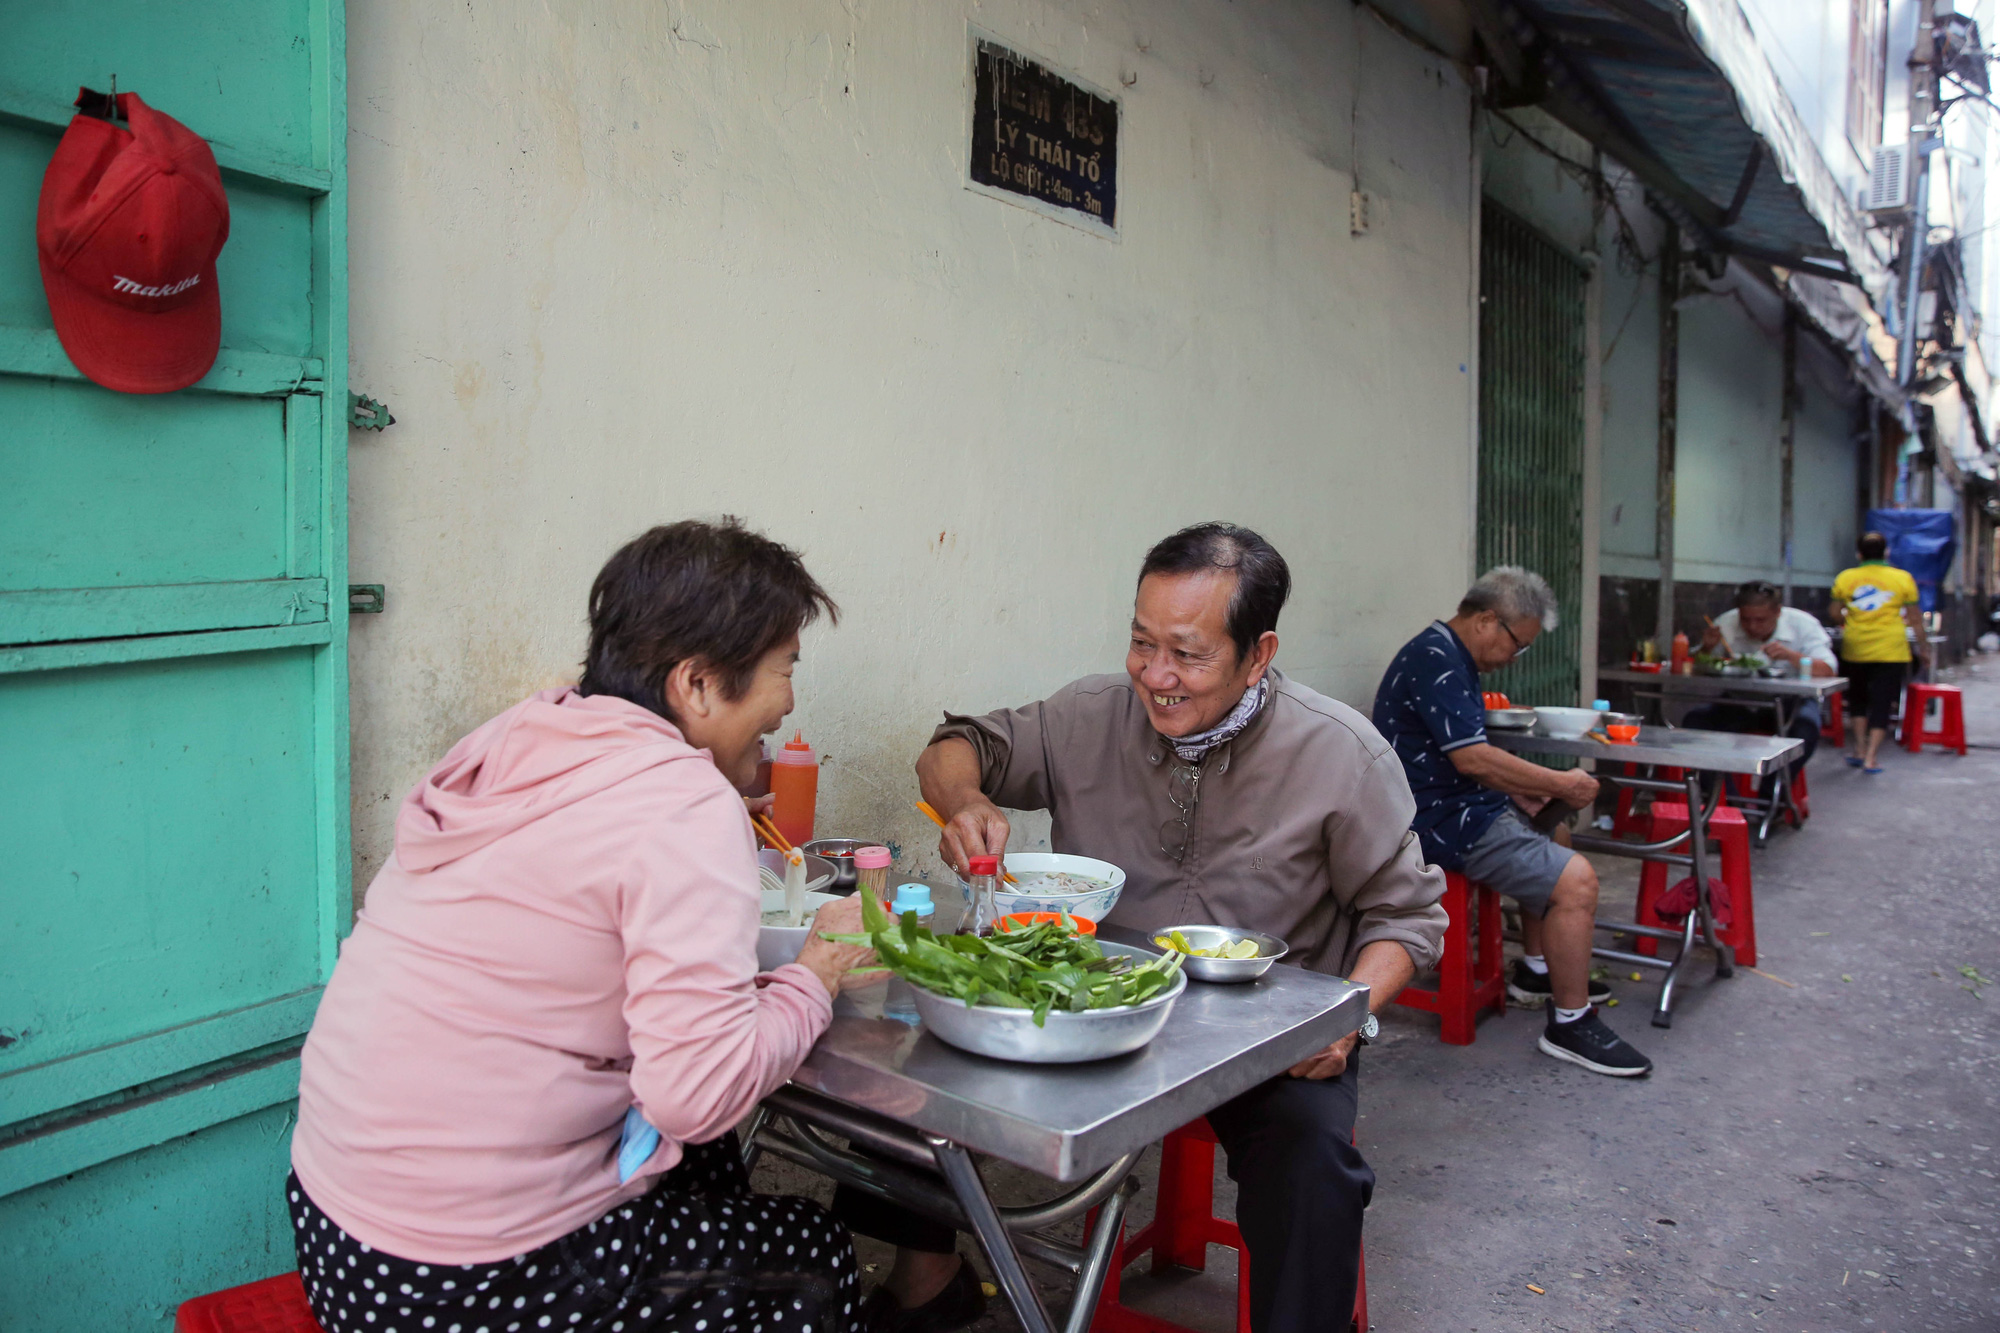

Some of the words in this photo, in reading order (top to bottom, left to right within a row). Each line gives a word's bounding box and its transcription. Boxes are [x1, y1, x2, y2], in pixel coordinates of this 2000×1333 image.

[1026, 133, 1071, 171] THÁI
[1076, 151, 1101, 183] TỔ
[1053, 179, 1072, 203] 4m
[1084, 191, 1102, 215] 3m
